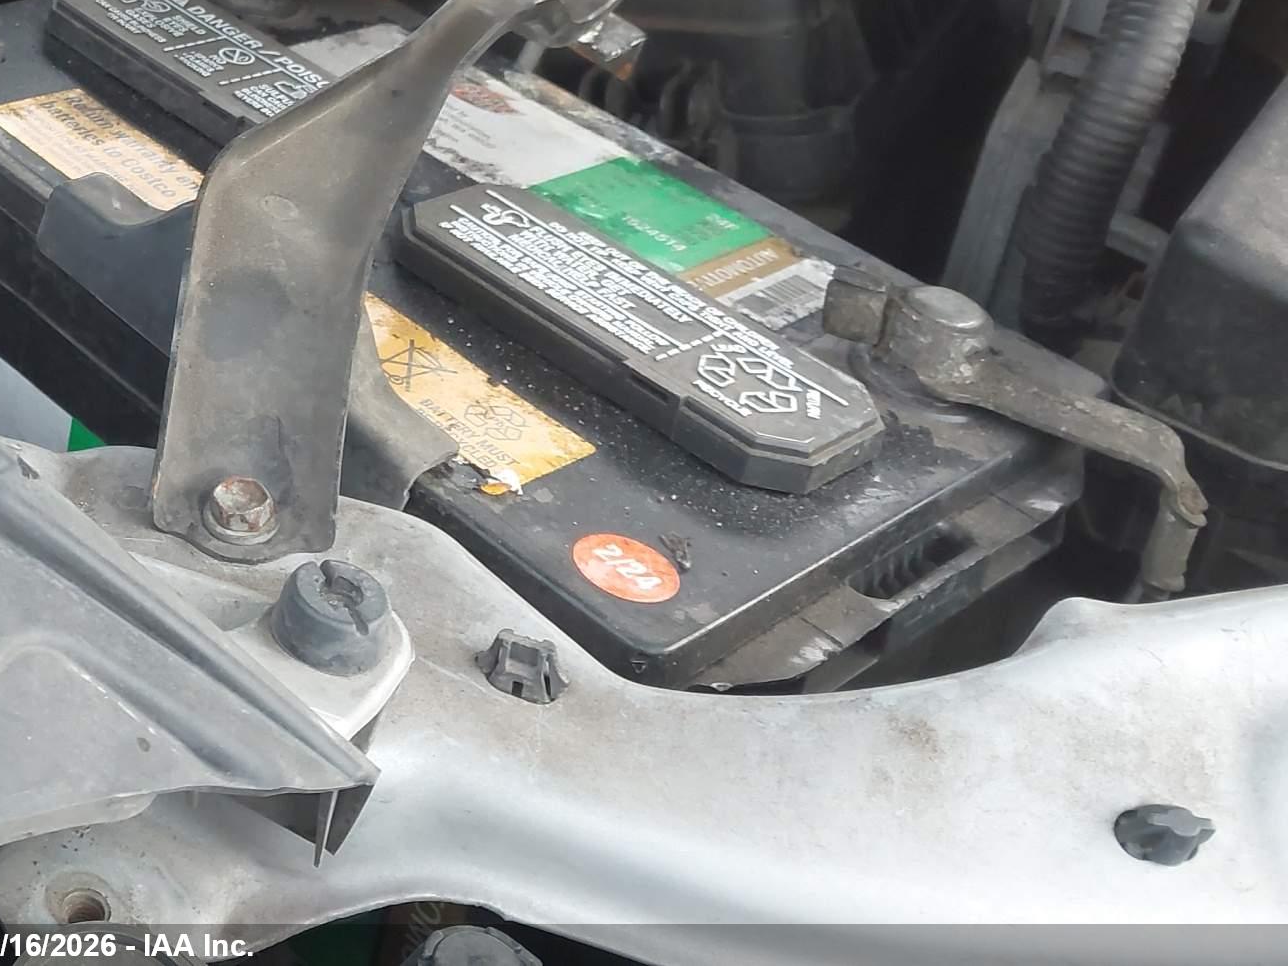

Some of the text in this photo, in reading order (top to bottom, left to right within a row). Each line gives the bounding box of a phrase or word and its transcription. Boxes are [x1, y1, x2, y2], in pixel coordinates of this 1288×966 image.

[170, 14, 207, 35] SHIELD
[186, 4, 264, 50] DANGER
[40, 100, 105, 145] batteries
[103, 145, 124, 158] to
[121, 158, 177, 197] Costco
[66, 94, 116, 130] Return
[111, 129, 178, 174] warranty
[516, 229, 558, 252] WITH
[597, 278, 633, 297] GET
[547, 221, 570, 233] DO
[564, 231, 592, 246] NOT
[506, 233, 638, 310] MEDICAL HELP FAST
[527, 225, 694, 323] FLUSH EYES IMMEDIATELY
[622, 319, 672, 347] FOLLOW
[691, 379, 753, 418] RECYCLE
[420, 399, 480, 437] BATTERY
[476, 439, 520, 466] MUST
